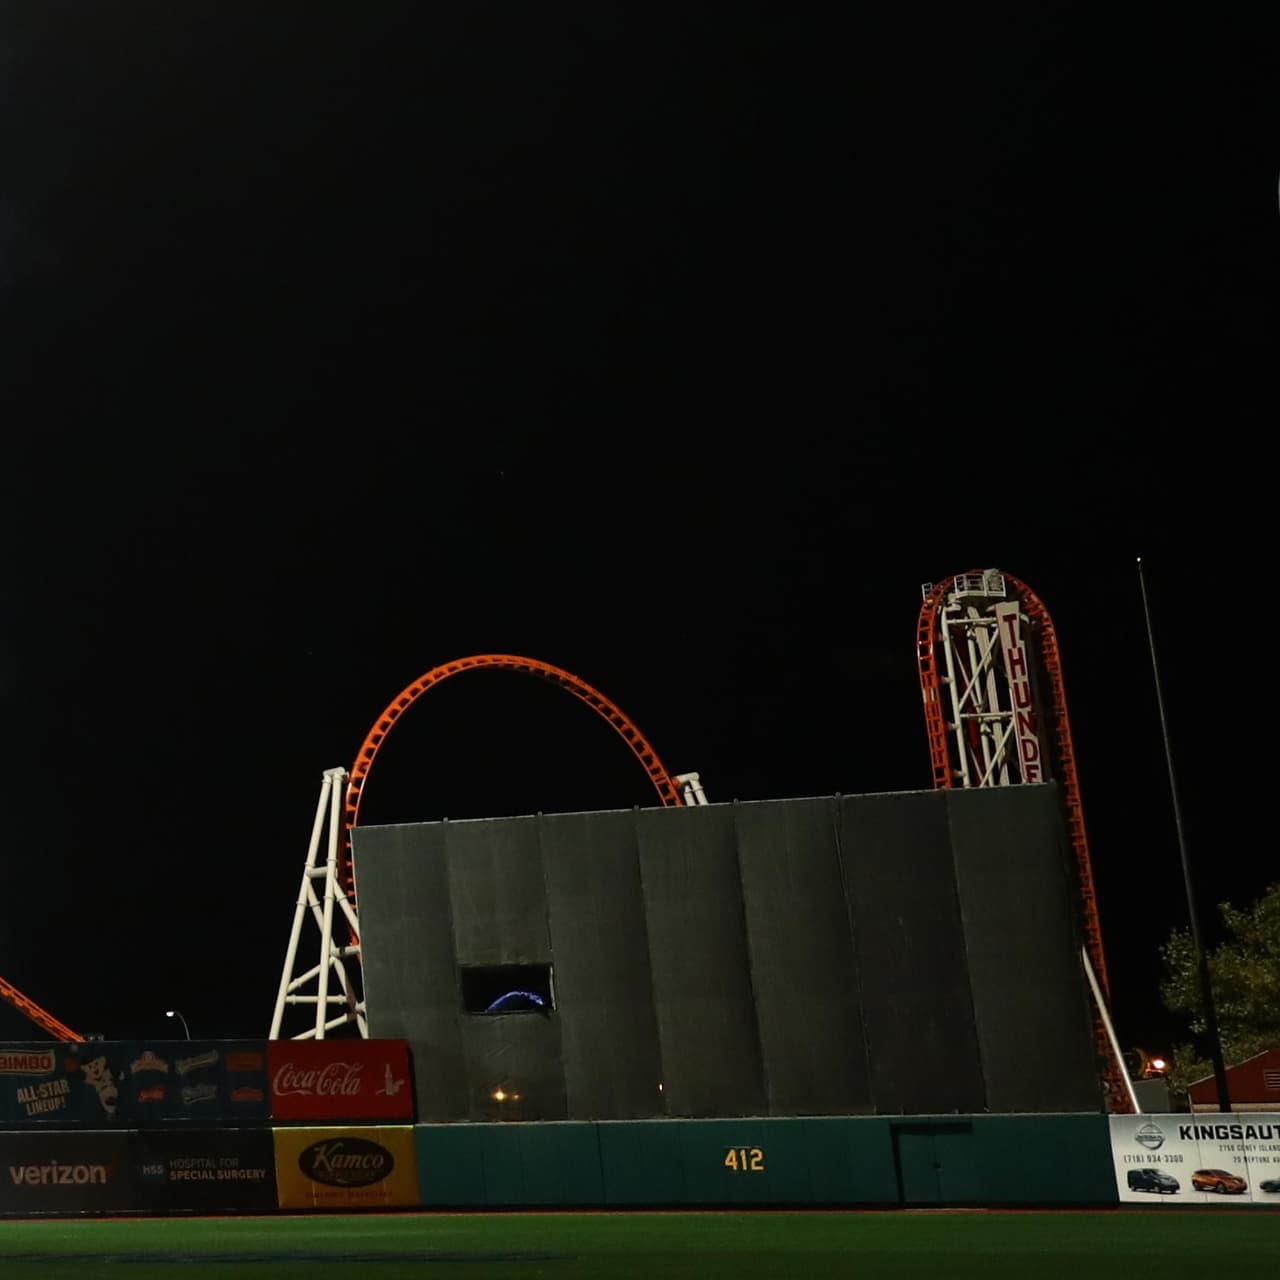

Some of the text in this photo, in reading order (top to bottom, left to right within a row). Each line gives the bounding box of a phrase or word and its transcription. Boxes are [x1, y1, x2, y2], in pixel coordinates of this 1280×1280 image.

[16, 1078, 71, 1104] ALL-STAR
[25, 1095, 67, 1116] LINEUP!
[169, 1157, 239, 1169] HOSPITAL FOR
[311, 1141, 385, 1173] Kamco
[724, 1147, 766, 1171] 412
[8, 1160, 107, 1185] verizon
[142, 1164, 164, 1176] HSS
[169, 1168, 267, 1181] SPECIAL SURGERY
